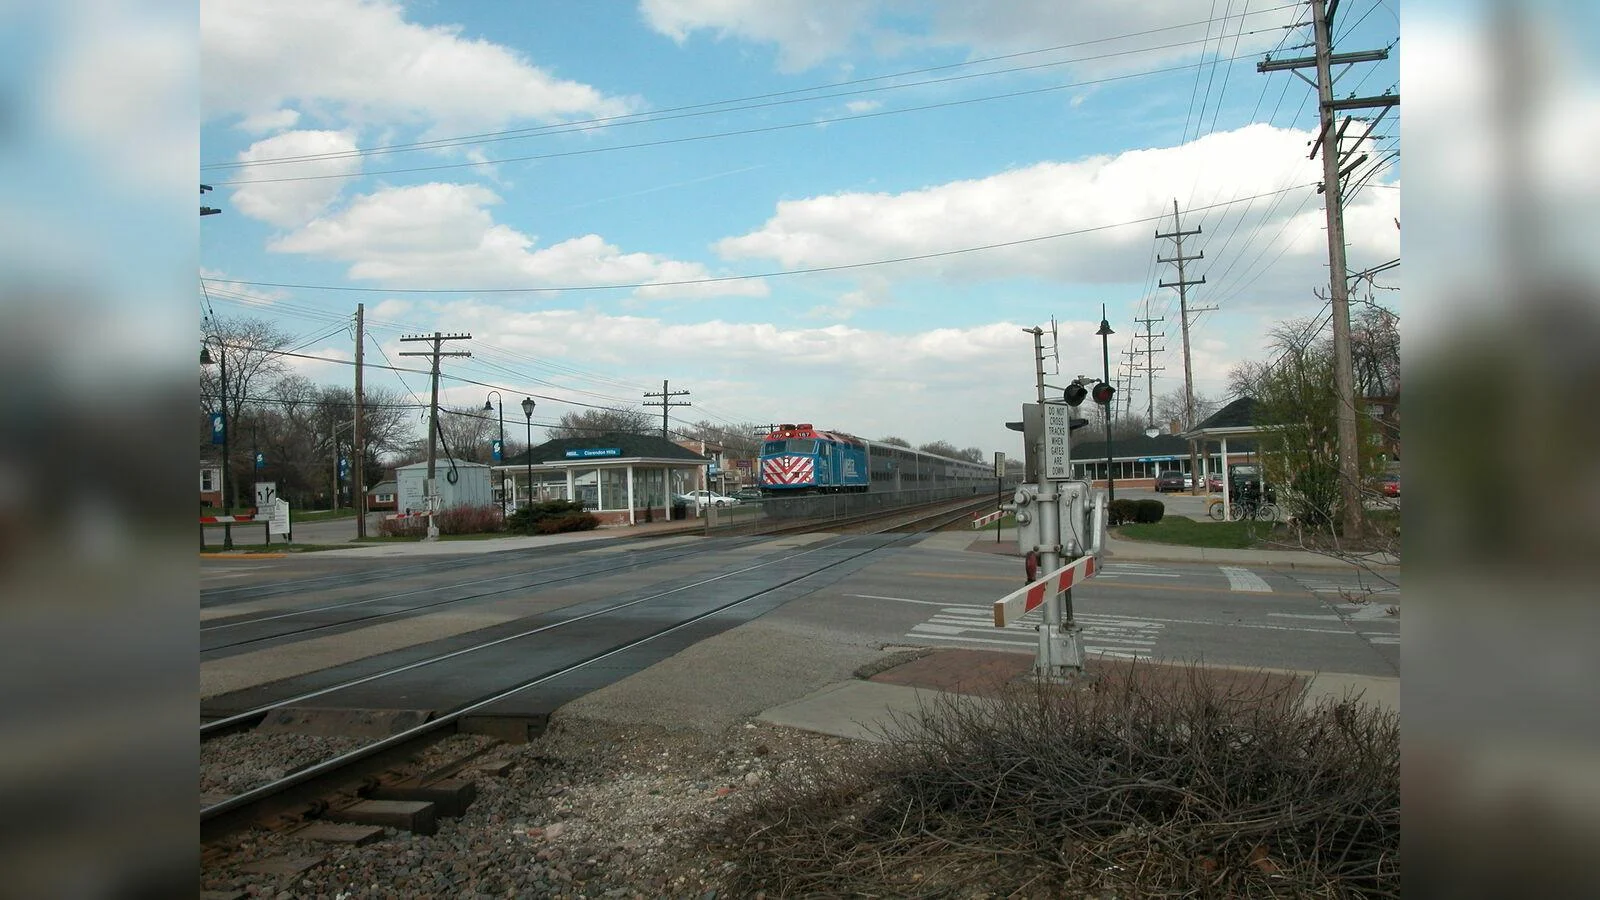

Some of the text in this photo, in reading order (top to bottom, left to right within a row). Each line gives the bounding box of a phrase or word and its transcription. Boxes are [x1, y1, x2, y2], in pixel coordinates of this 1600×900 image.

[1048, 407, 1065, 416] DO NOT
[1049, 416, 1064, 426] CROSS
[1048, 426, 1065, 436] TRACKS
[1051, 437, 1064, 446] WHEN
[1051, 446, 1064, 456] GATES
[1053, 456, 1062, 465] ARE
[1052, 467, 1064, 476] DOWN
